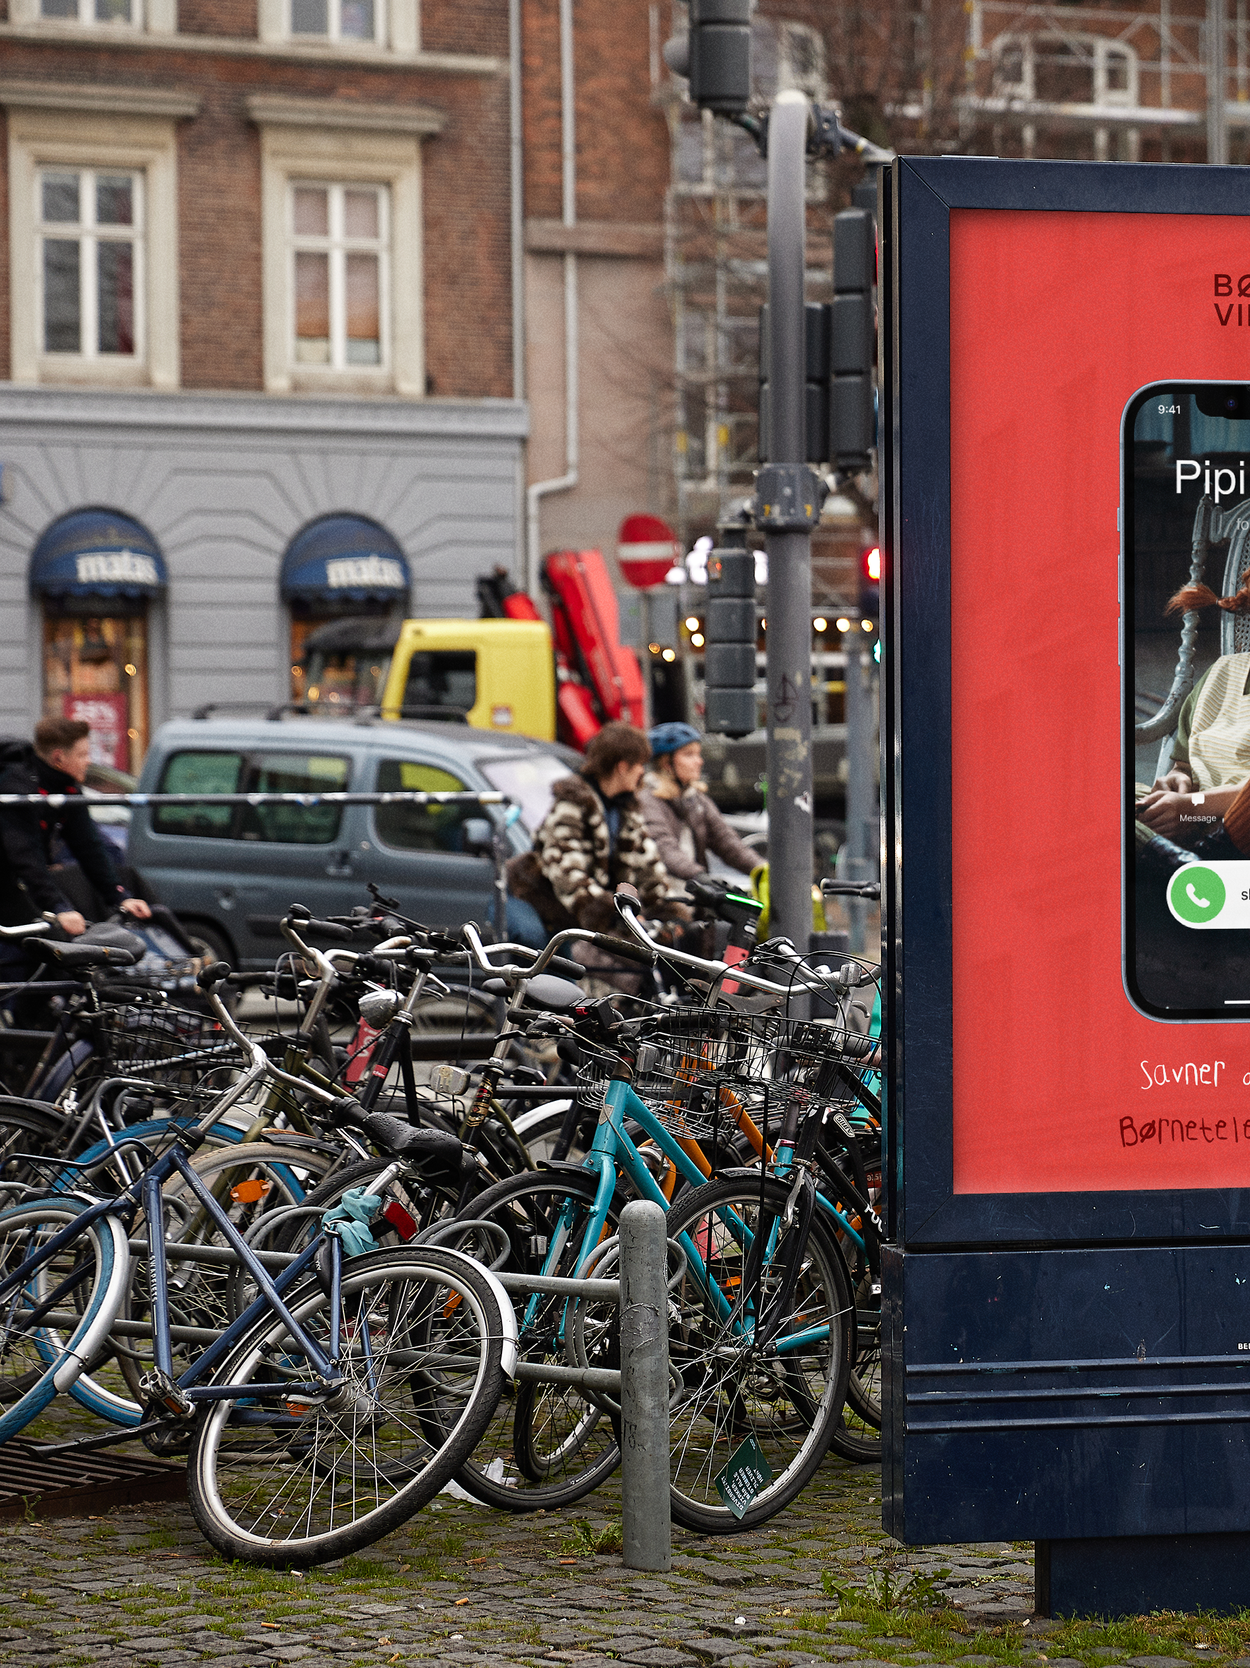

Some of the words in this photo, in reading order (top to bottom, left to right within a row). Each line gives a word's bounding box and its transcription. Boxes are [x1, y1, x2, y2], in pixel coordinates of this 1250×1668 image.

[1157, 404, 1182, 416] 9:41
[1175, 459, 1246, 505] Pipi
[1179, 813, 1218, 824] Message
[1139, 1059, 1226, 1090] Savner
